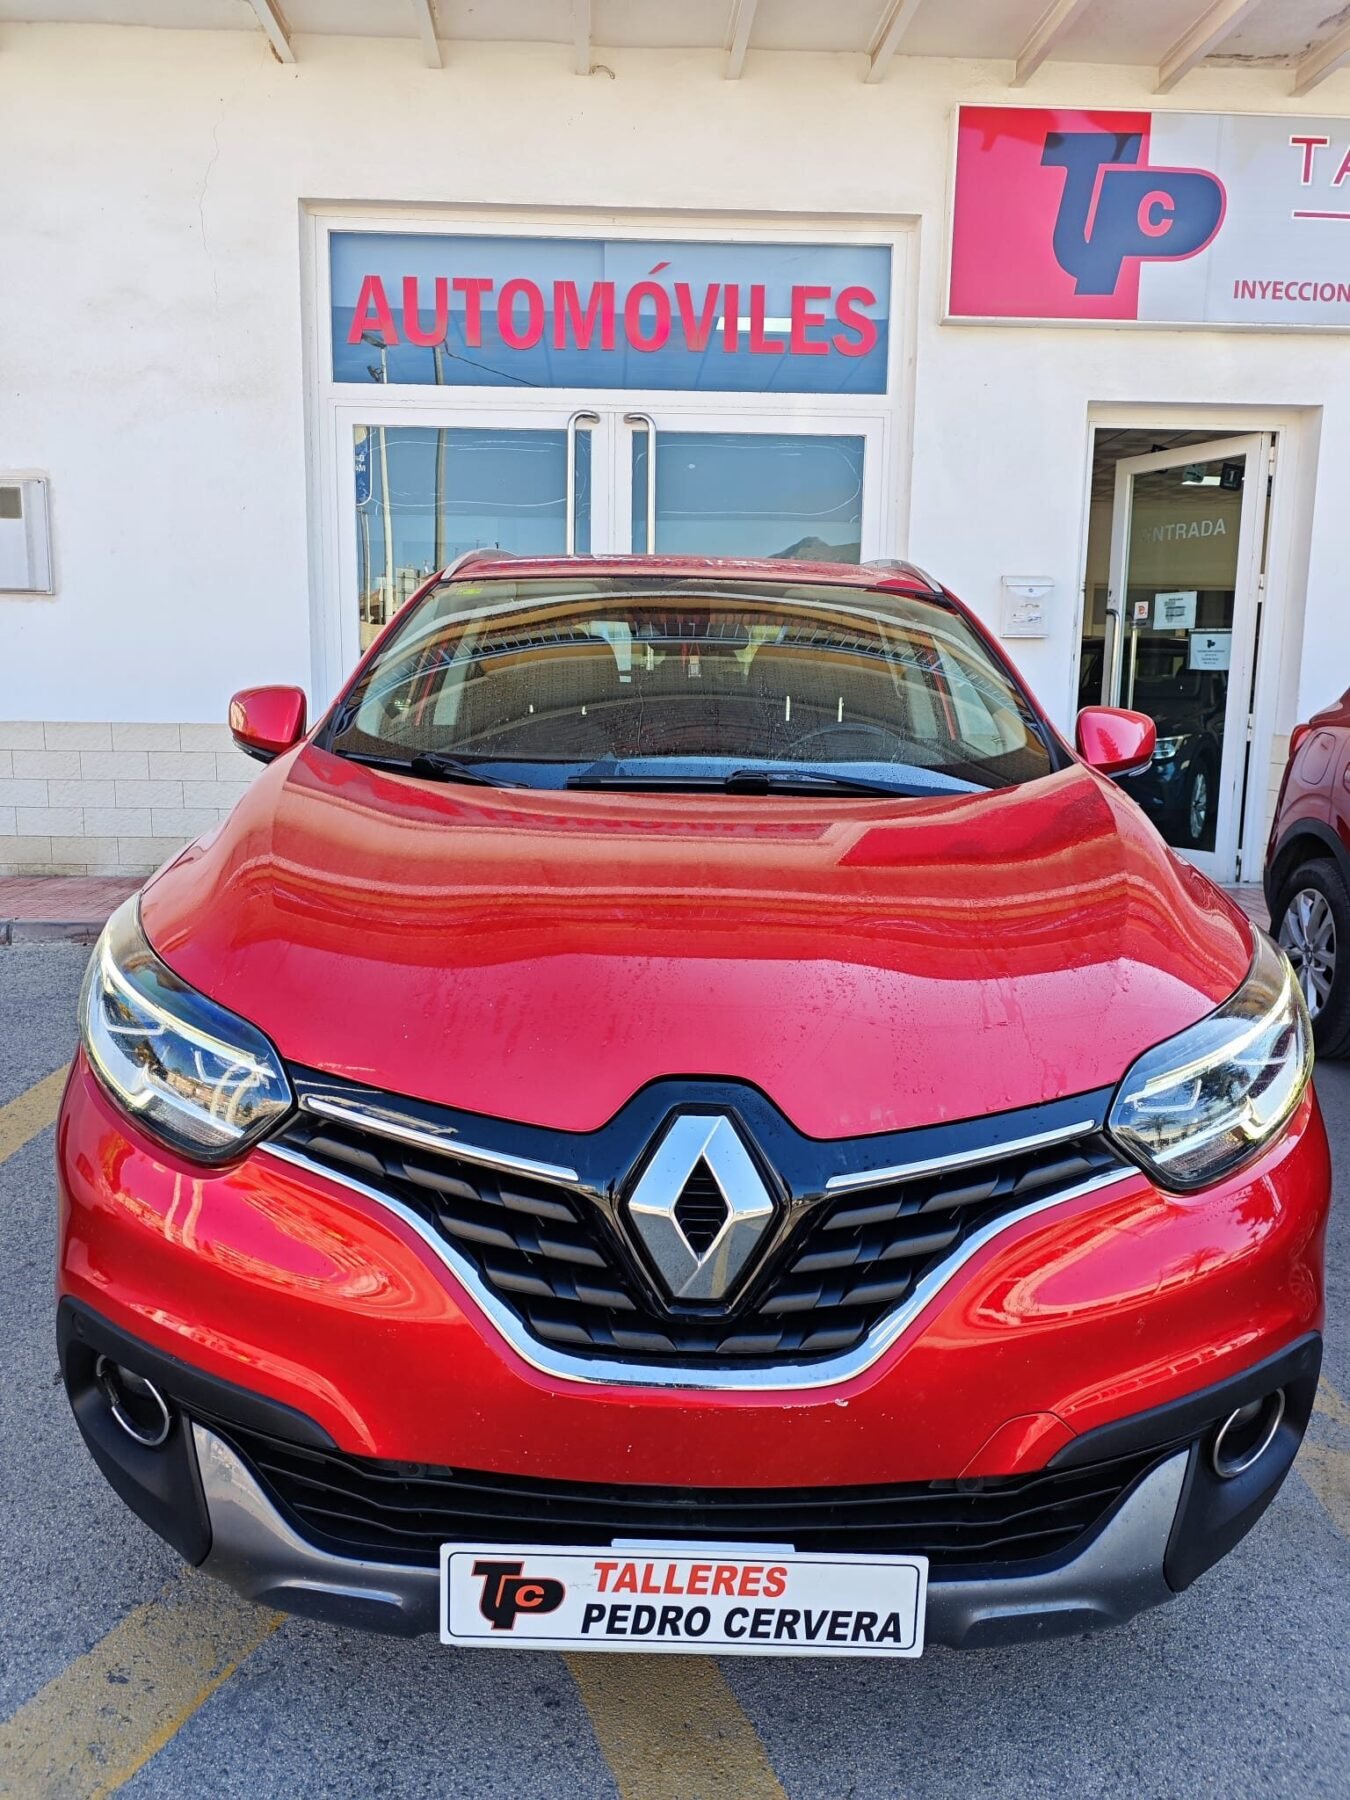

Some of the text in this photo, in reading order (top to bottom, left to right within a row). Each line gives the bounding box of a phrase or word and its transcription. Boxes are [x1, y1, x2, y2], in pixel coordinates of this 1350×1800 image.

[347, 262, 878, 357] AUTOMÓVILES
[594, 1562, 788, 1598] TALLERES
[580, 1603, 902, 1644] PEDRO CERVERA
